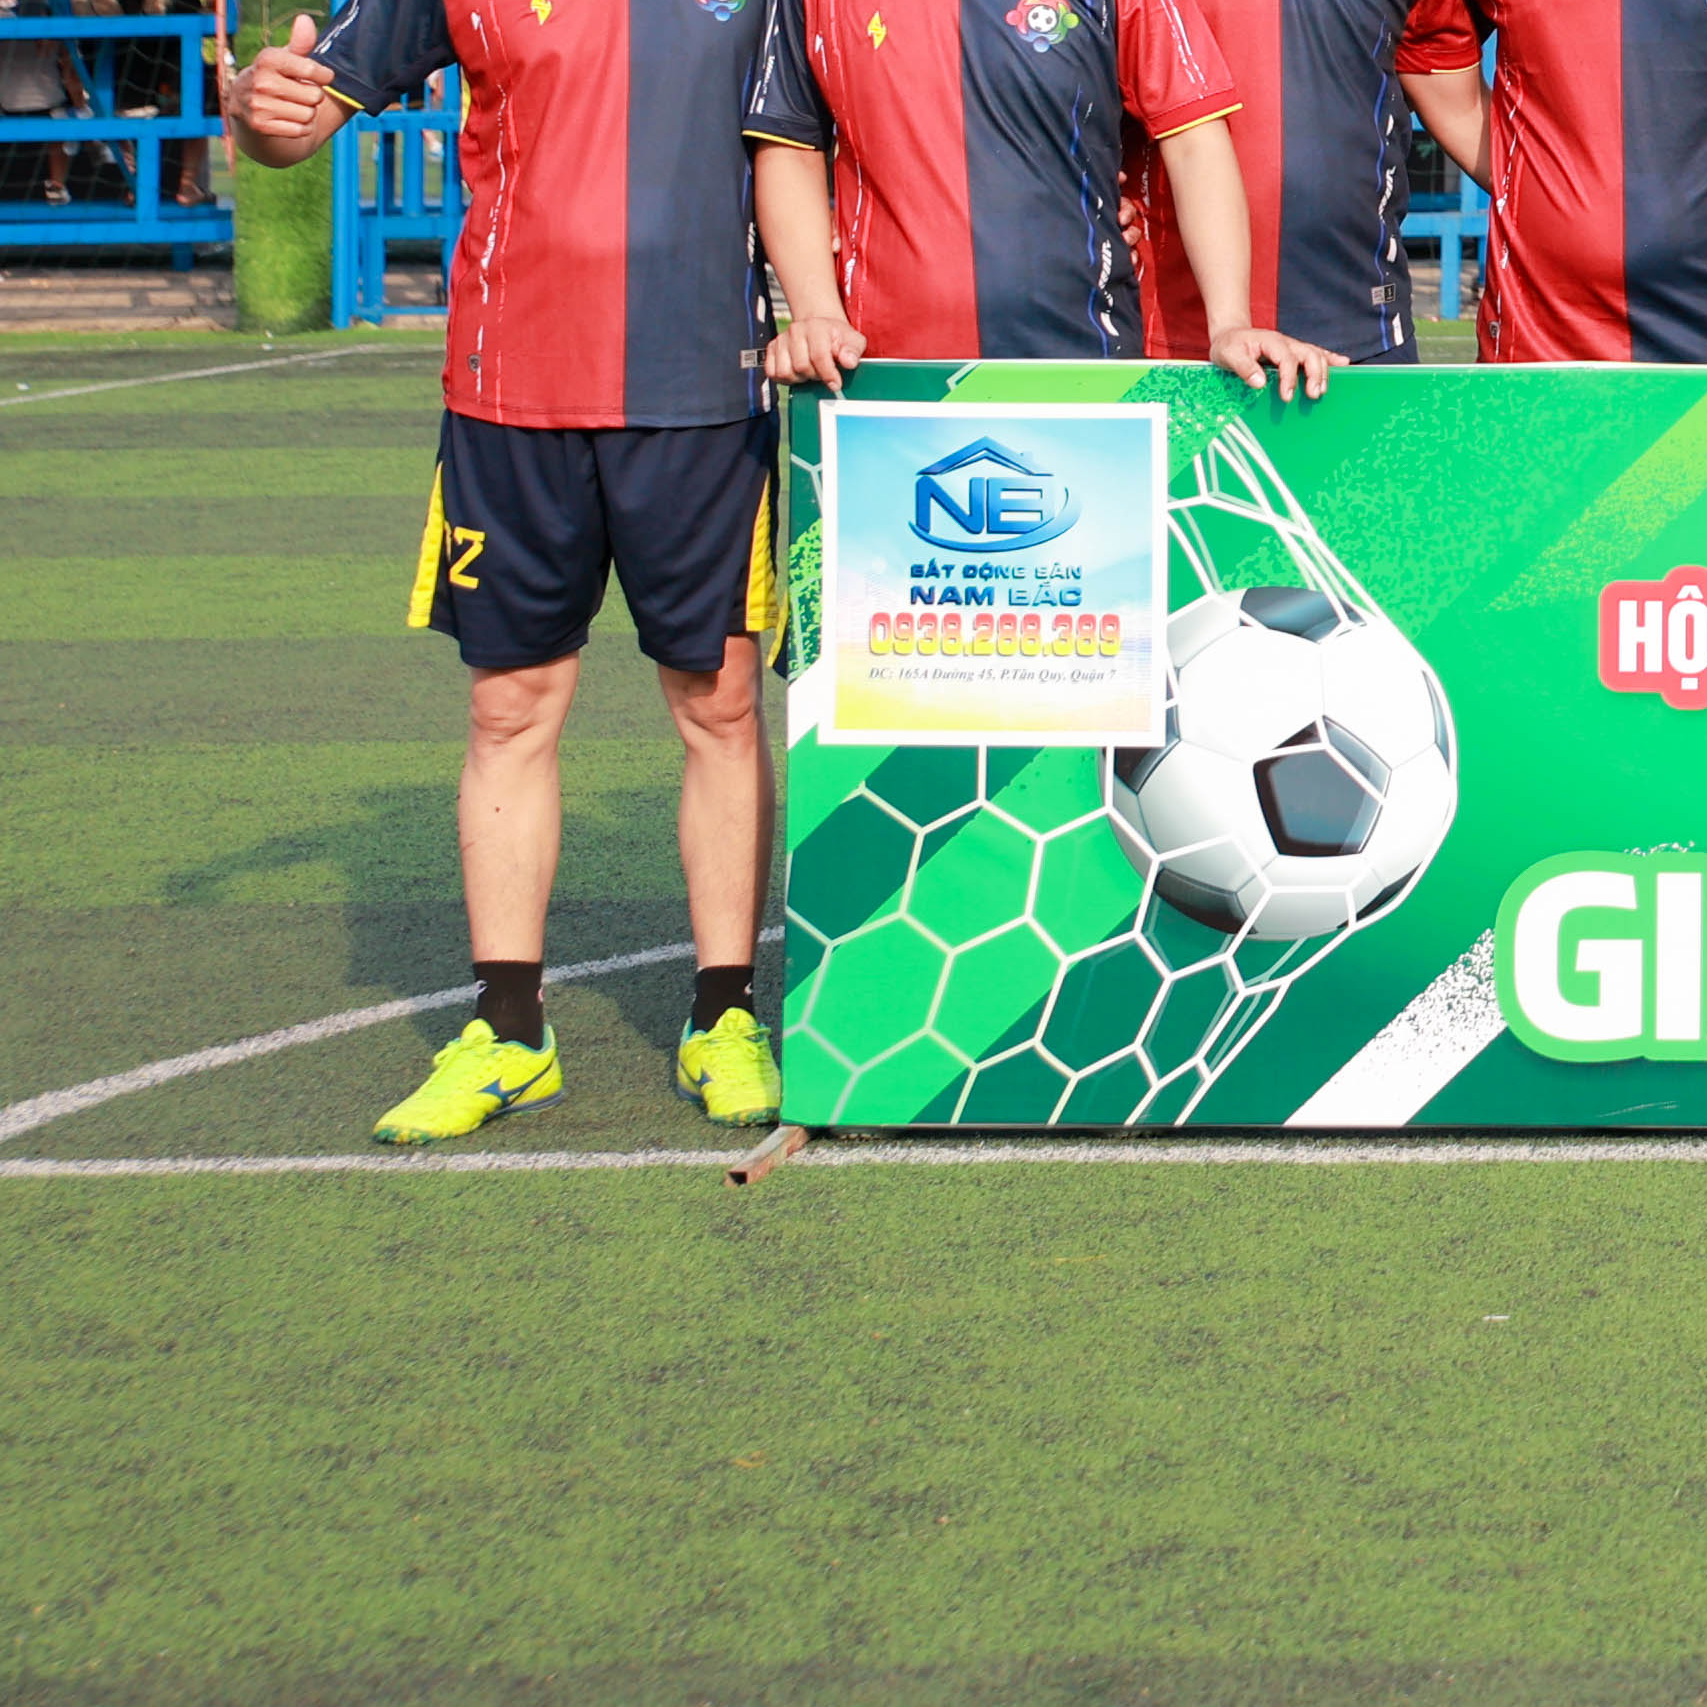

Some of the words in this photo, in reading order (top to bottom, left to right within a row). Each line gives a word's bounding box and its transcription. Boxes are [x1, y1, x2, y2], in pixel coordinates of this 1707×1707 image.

[910, 585, 995, 606] NAM
[1008, 581, 1083, 607] BẮC
[869, 612, 1122, 657] 0938.288.389
[898, 667, 929, 680] 165A
